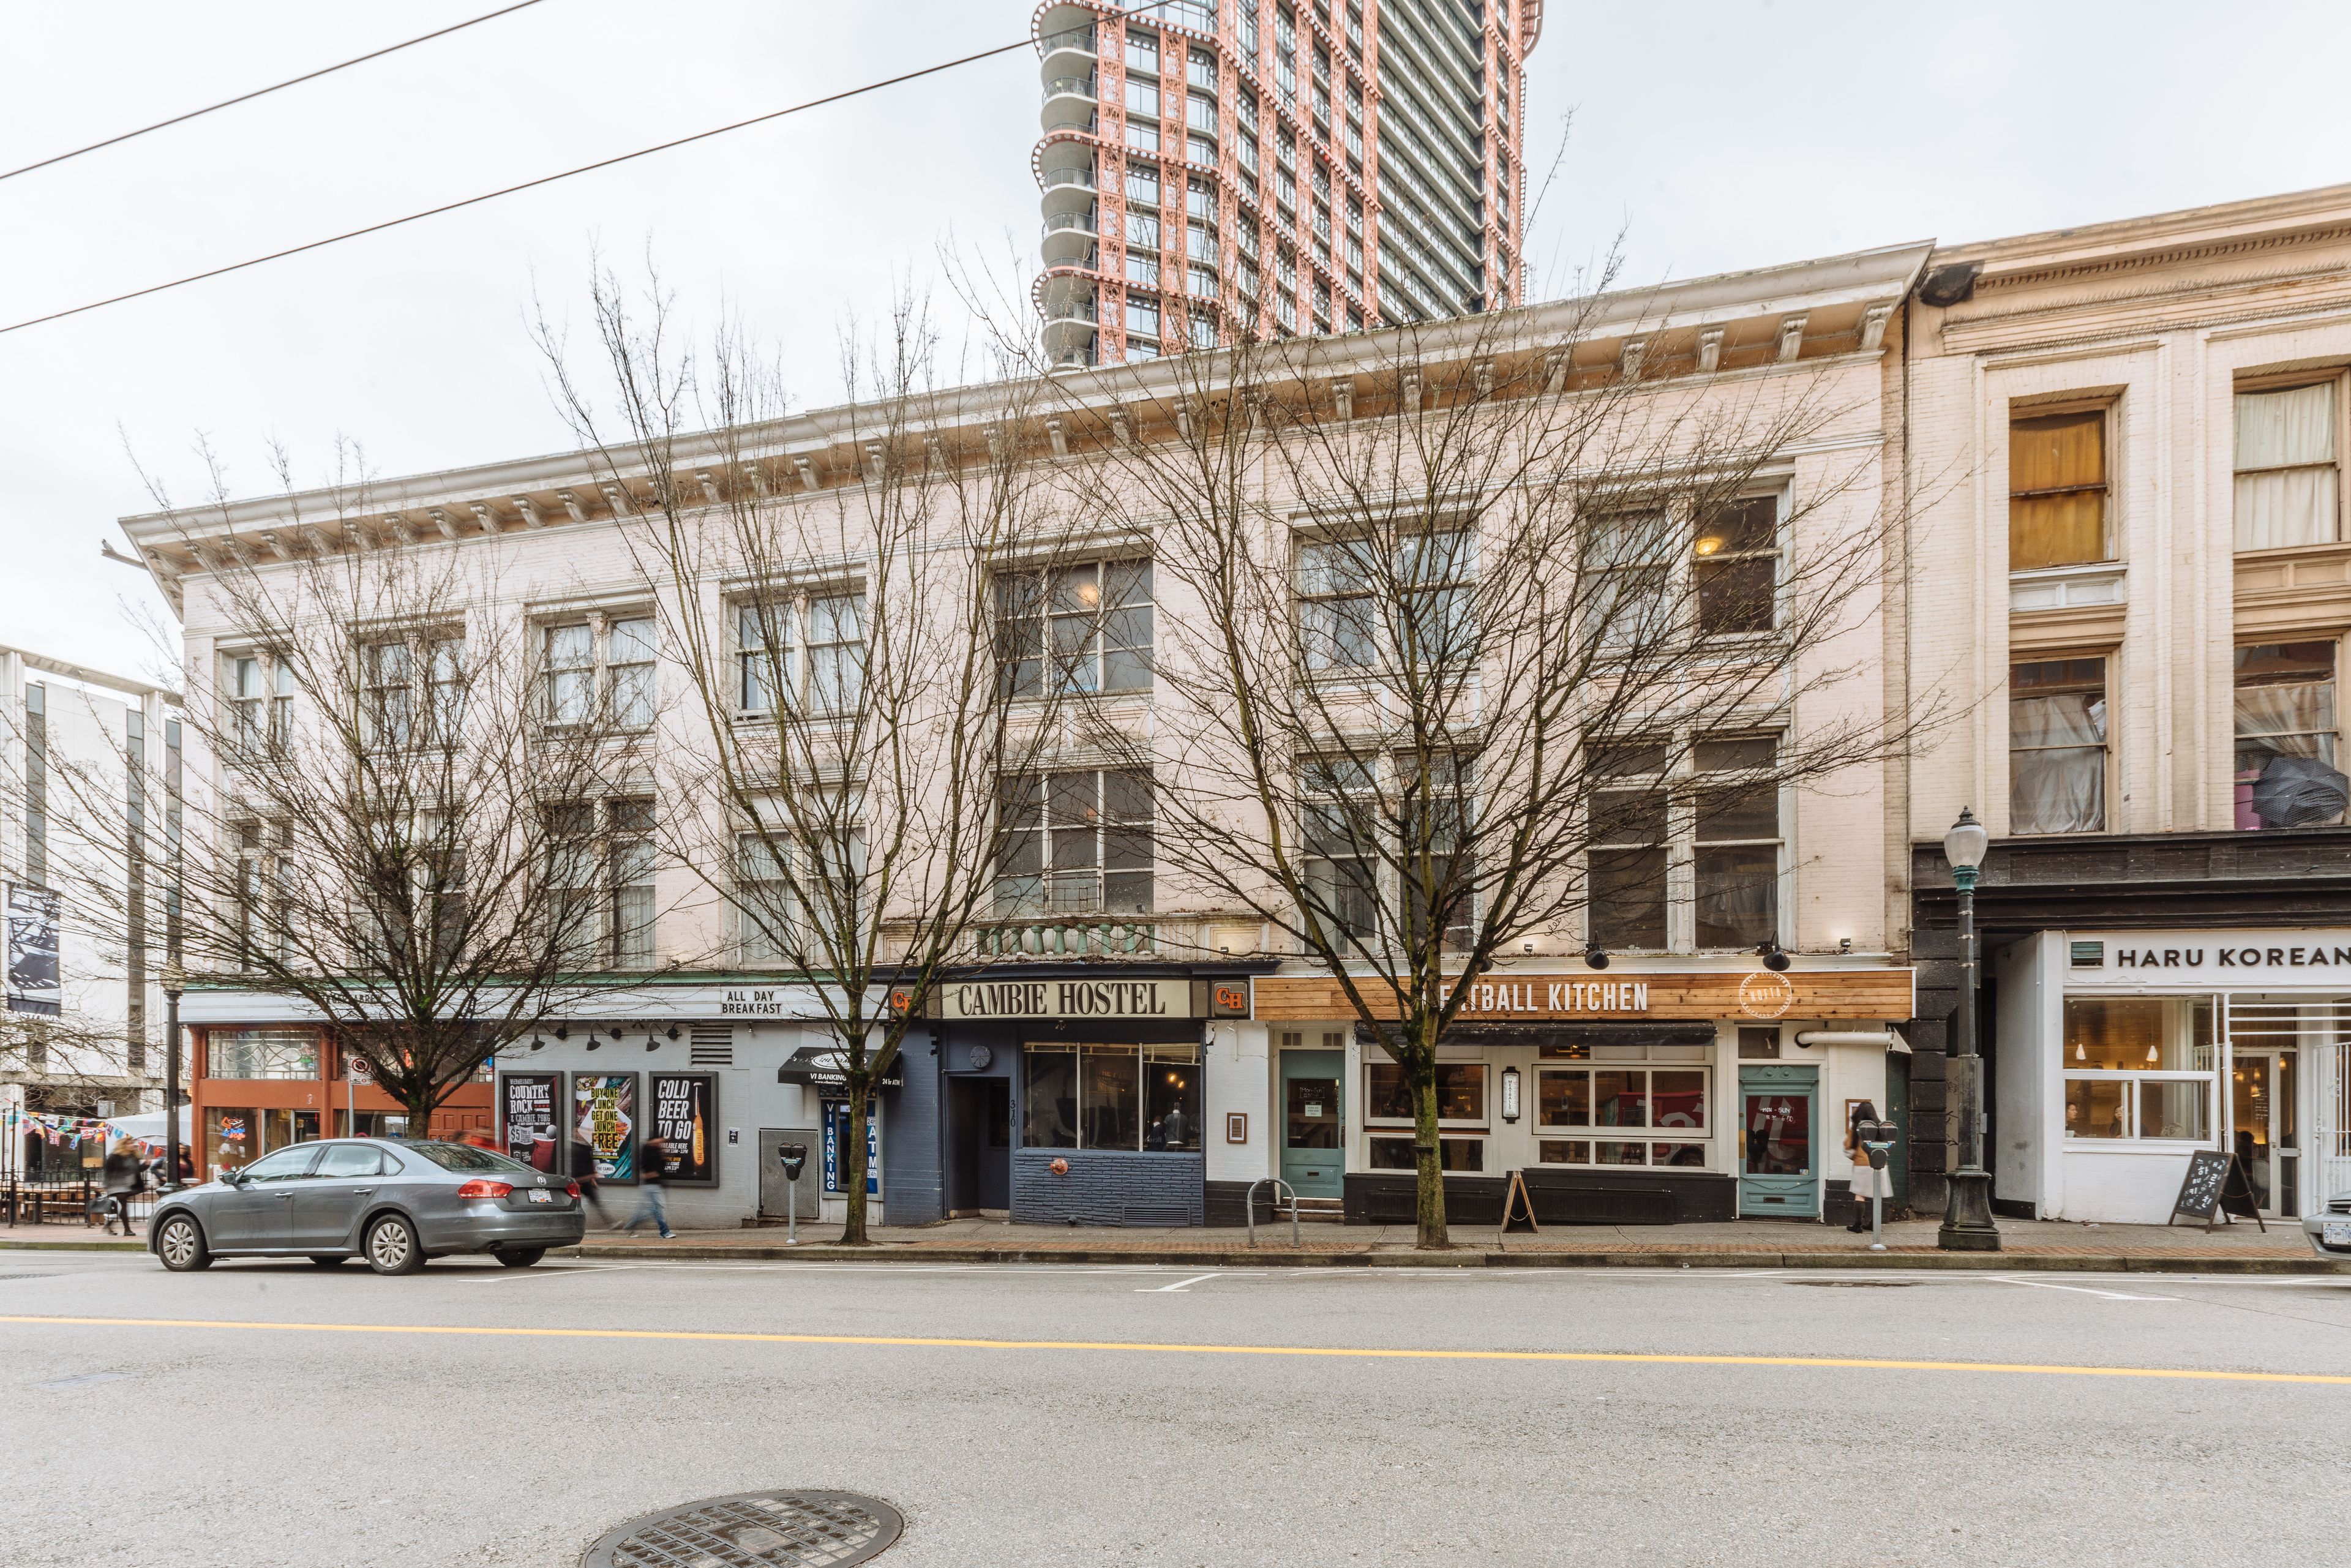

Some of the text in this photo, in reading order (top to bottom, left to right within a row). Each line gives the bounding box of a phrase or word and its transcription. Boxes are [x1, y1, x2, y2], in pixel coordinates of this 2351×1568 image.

[2118, 947, 2351, 967] HARU KOREAN
[727, 991, 774, 1001] ALL DAY
[958, 982, 1166, 1016] CAMBIE HOSTEL
[1216, 987, 1244, 1010] CH
[1548, 983, 1648, 1011] KITCHEN
[1750, 987, 1782, 1002] KOFTA
[722, 1003, 782, 1013] BREAKFAST
[510, 1084, 550, 1099] COUNTRY
[591, 1088, 618, 1098] BUY ONE
[658, 1079, 690, 1099] COLD
[510, 1099, 533, 1114] ROCK
[594, 1100, 615, 1109] LUNCH
[658, 1100, 689, 1119] BEER
[516, 1114, 536, 1122] CAMBIE
[537, 1114, 550, 1122] PONG
[591, 1111, 618, 1121] GET ONE
[511, 1127, 520, 1141] $5
[594, 1122, 615, 1132] LUNCH
[658, 1120, 692, 1139] TO GO
[591, 1133, 619, 1150] FREE
[868, 1126, 877, 1168] ATM
[827, 1127, 835, 1190] BANKING
